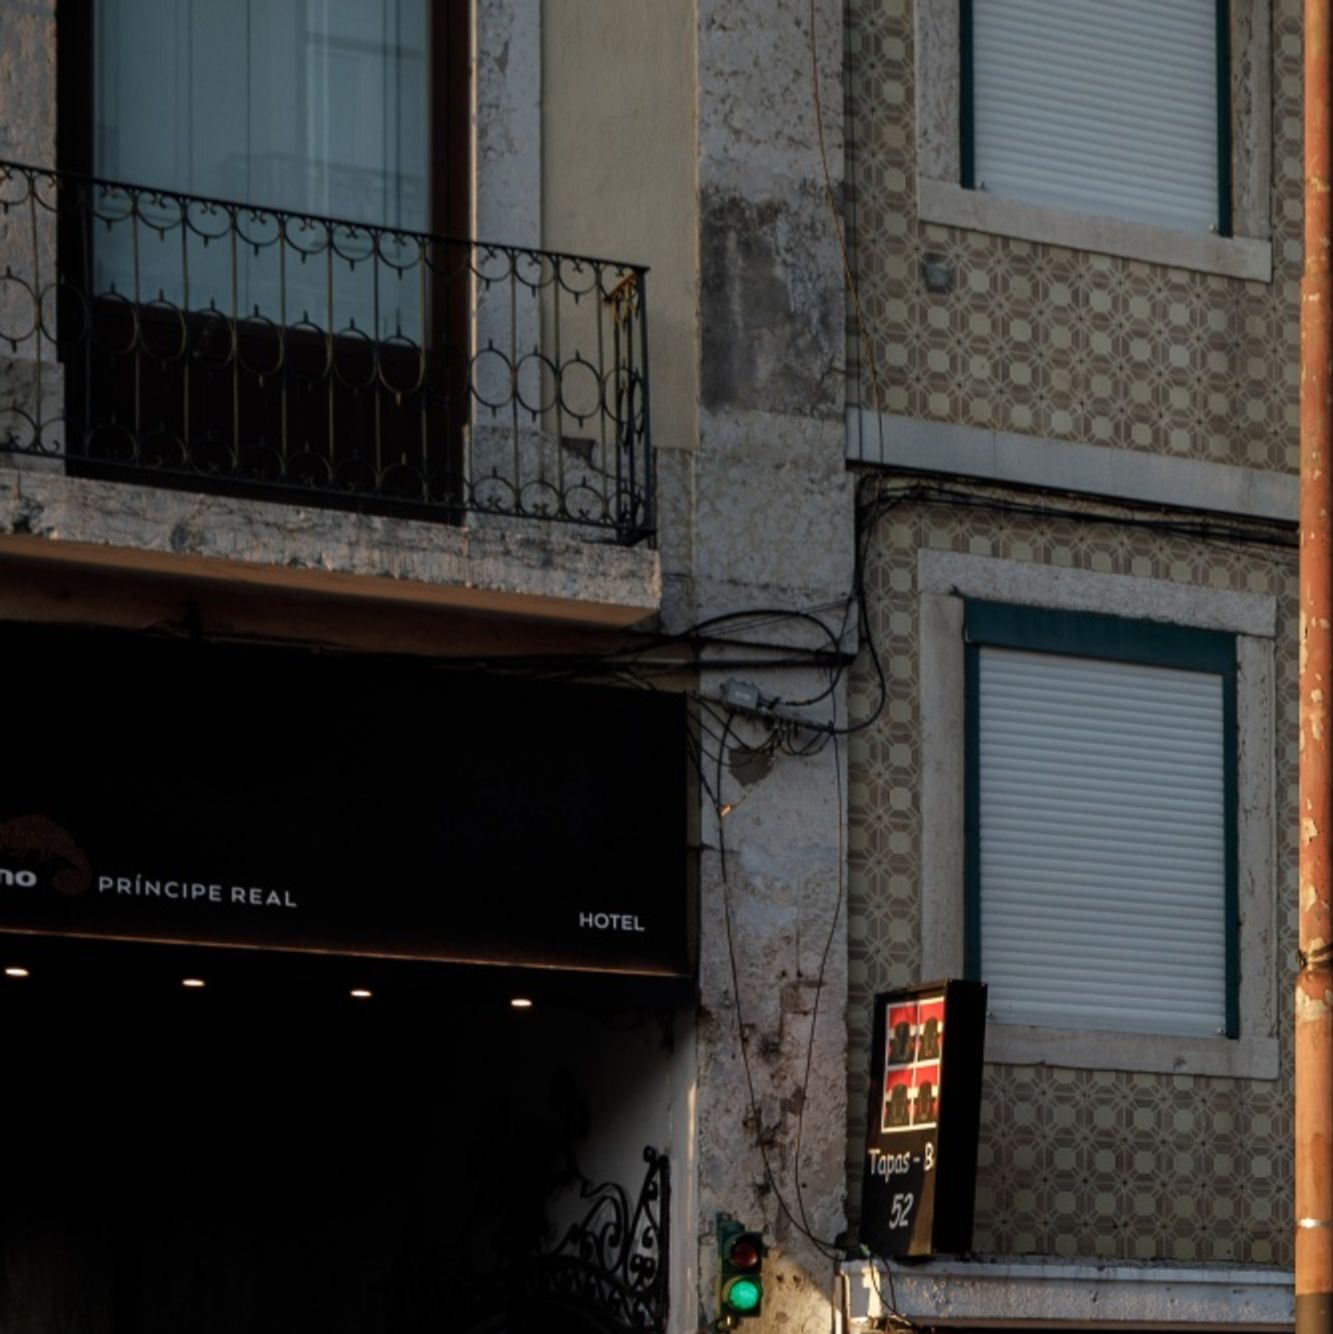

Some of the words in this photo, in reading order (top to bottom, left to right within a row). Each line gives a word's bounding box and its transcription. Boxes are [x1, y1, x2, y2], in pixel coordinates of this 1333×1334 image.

[98, 873, 223, 902] PRÍNCIPE
[230, 886, 298, 909] REAL
[579, 911, 646, 932] HOTEL
[868, 1149, 911, 1183] Tapas
[889, 1193, 914, 1229] 52
